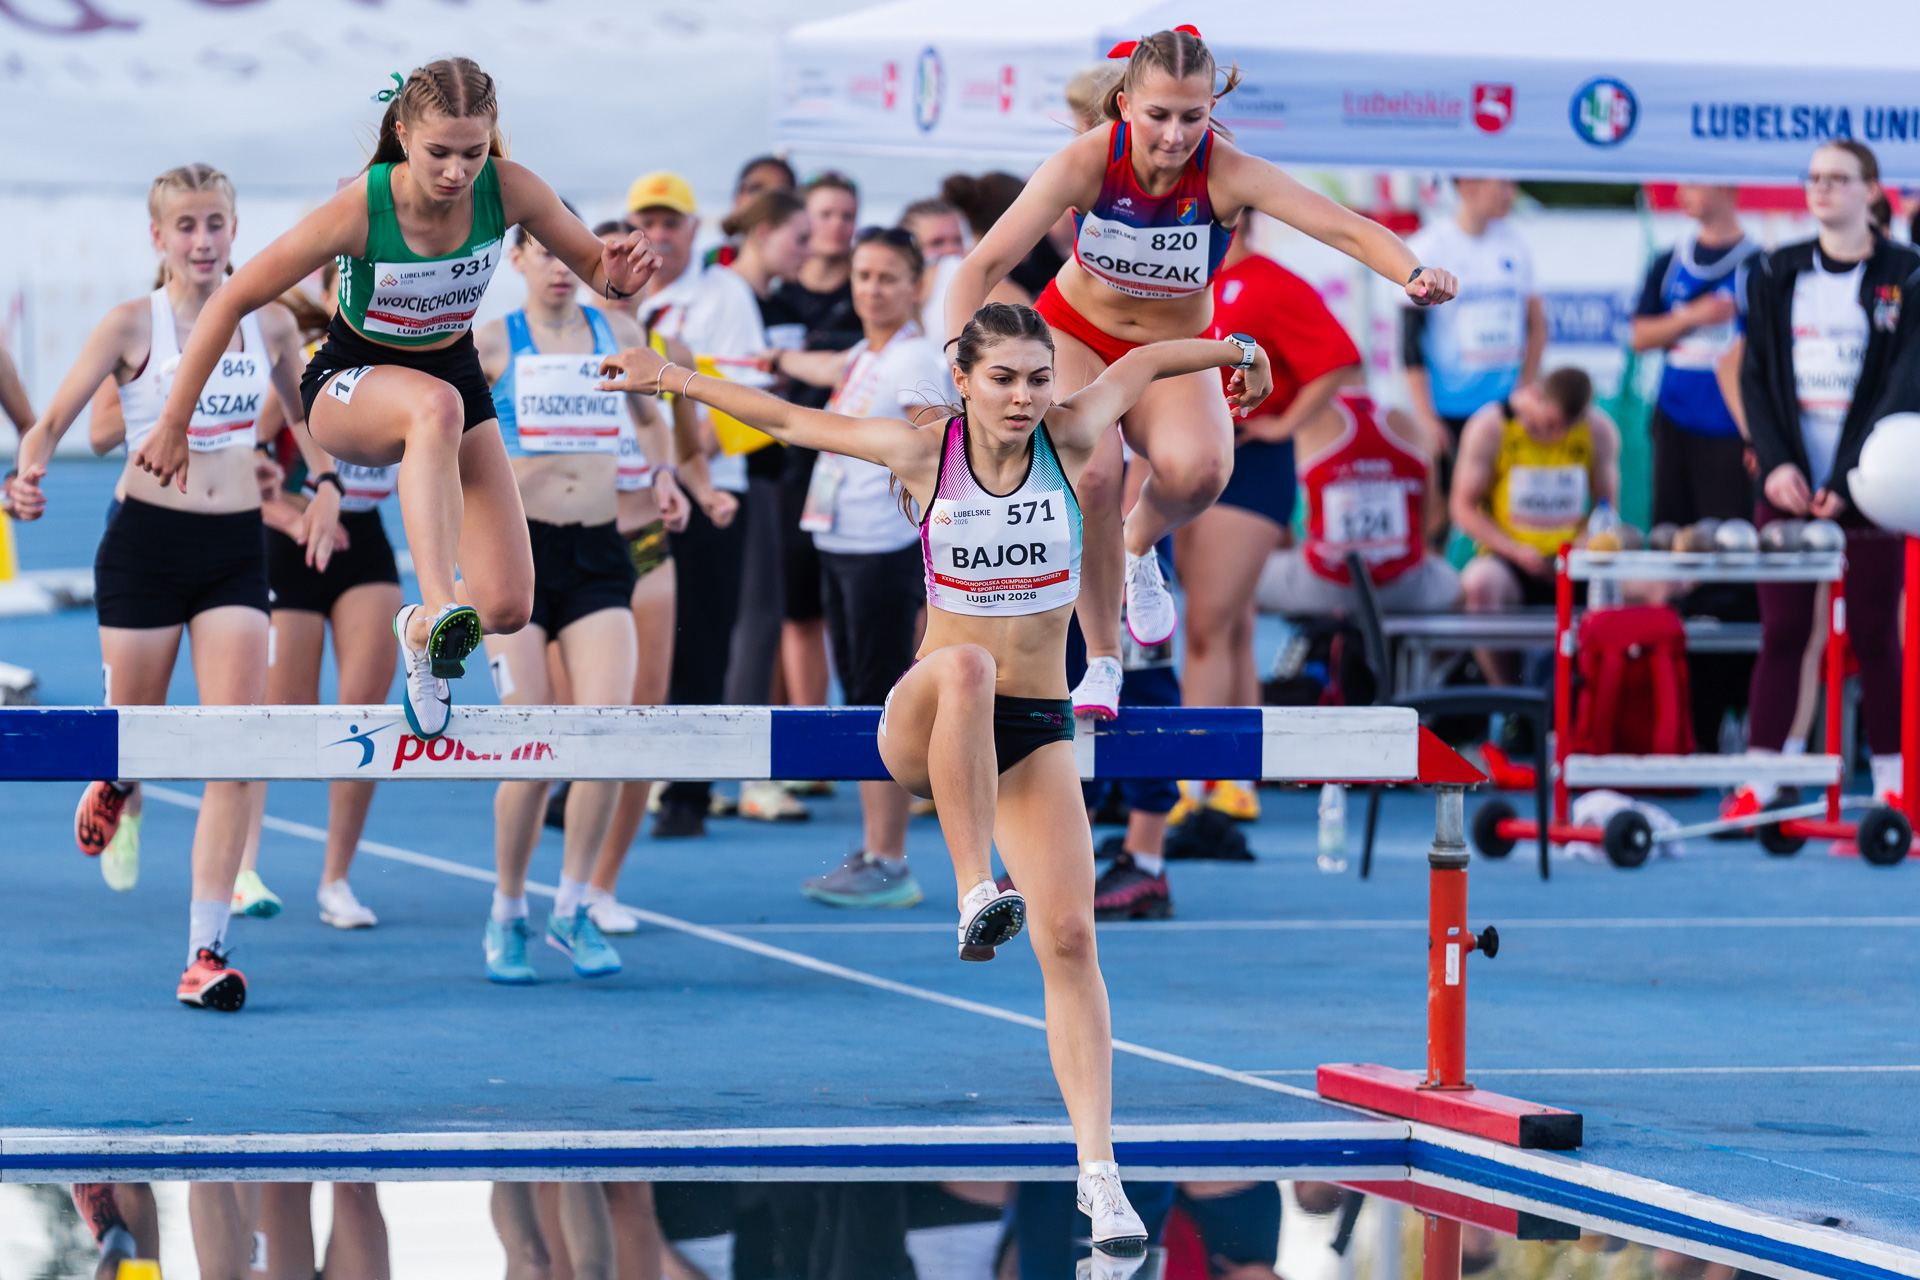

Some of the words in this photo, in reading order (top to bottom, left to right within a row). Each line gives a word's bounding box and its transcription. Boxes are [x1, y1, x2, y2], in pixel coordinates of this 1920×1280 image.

[1343, 90, 1462, 118] Lubelskie
[1691, 103, 1852, 139] LUBELSKA
[1103, 227, 1138, 242] LUBELSKIE
[1151, 231, 1198, 251] 820
[400, 270, 437, 279] LUBELSKIE
[451, 253, 492, 280] 931
[1082, 251, 1201, 285] SOBCZAK
[1107, 281, 1143, 296] LUBLIN
[397, 325, 435, 335] LUBLIN
[437, 322, 465, 331] 2026
[222, 359, 256, 378] 849
[194, 393, 260, 416] ASZAK
[521, 394, 618, 416] STASZKIEWICZ
[953, 509, 991, 518] LUBELSKIE
[1006, 499, 1055, 526] 571
[952, 542, 1047, 570] BAJOR
[955, 577, 1000, 588] OGÓLNOPOLSKA
[1001, 577, 1032, 585] OLIMPIADA
[977, 584, 1008, 592] SPORTACH
[966, 593, 1005, 603] LUBLIN
[1008, 591, 1037, 601] 2026
